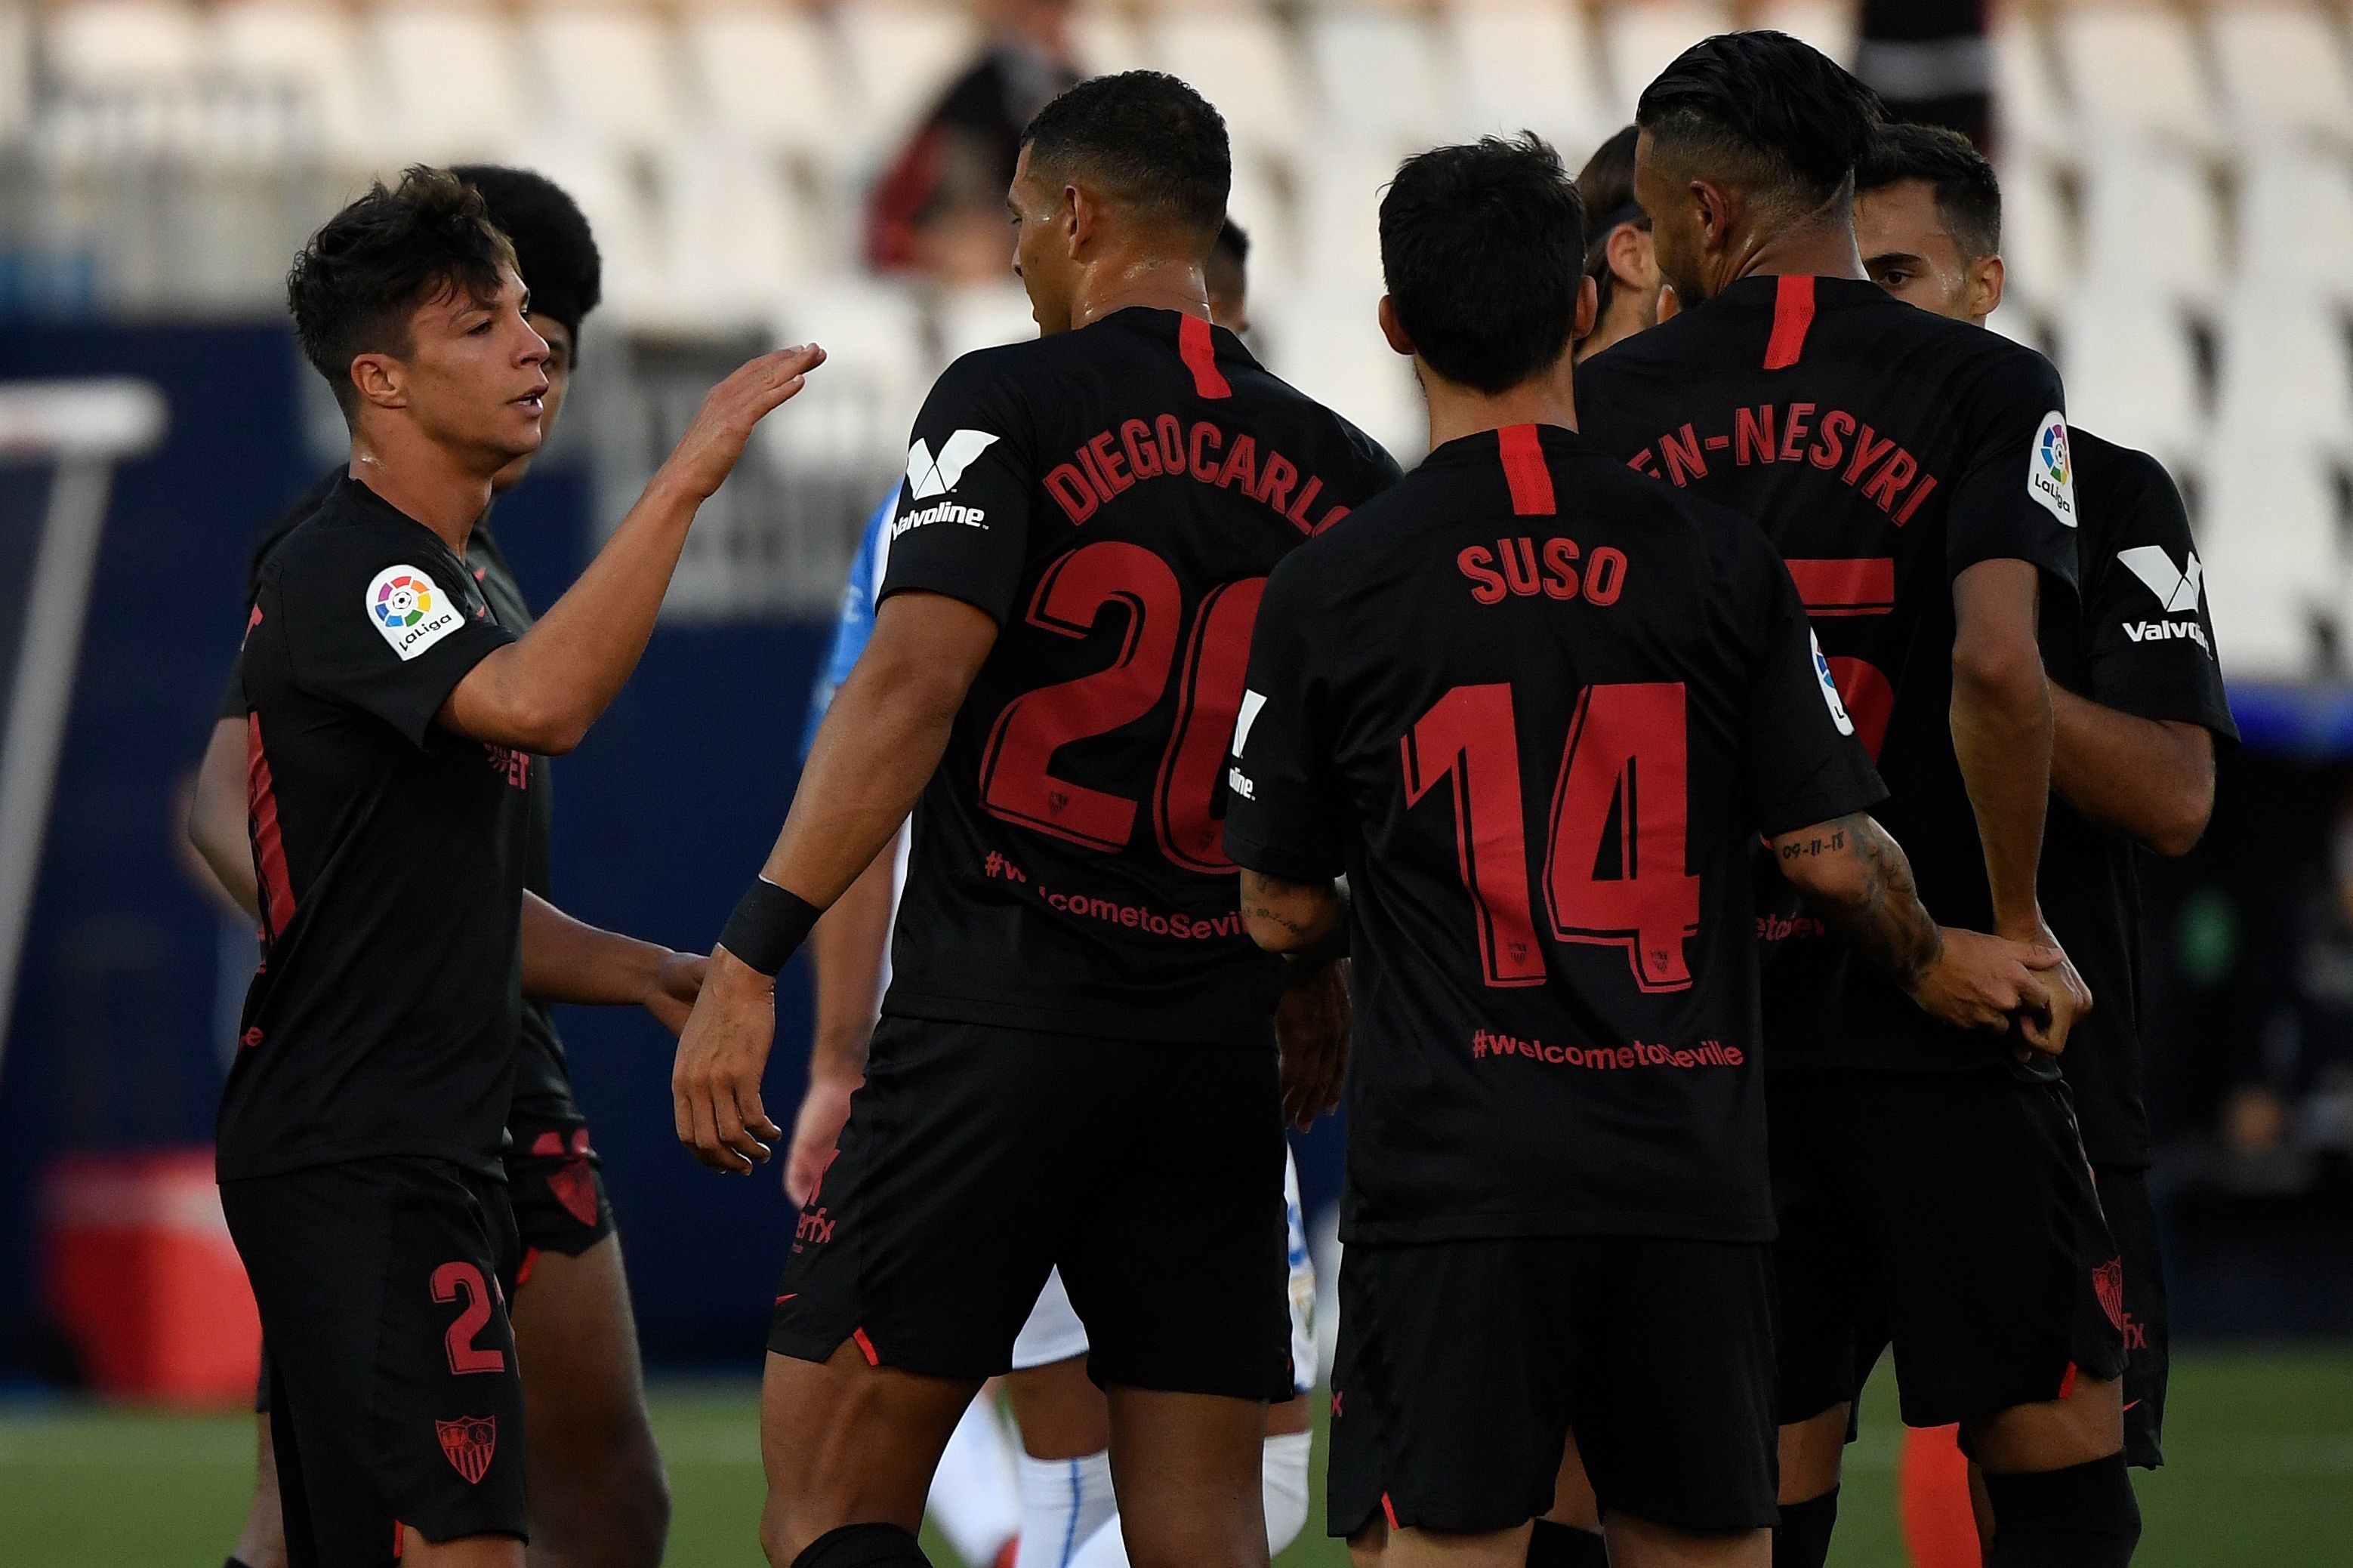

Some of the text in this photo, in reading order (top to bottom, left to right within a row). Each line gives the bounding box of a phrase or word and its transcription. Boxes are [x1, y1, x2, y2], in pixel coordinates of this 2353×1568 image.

[2035, 473, 2071, 513] LaLiga
[1457, 537, 1627, 606] SUSO
[399, 614, 452, 652] LaLiga
[1400, 682, 1700, 993] 14
